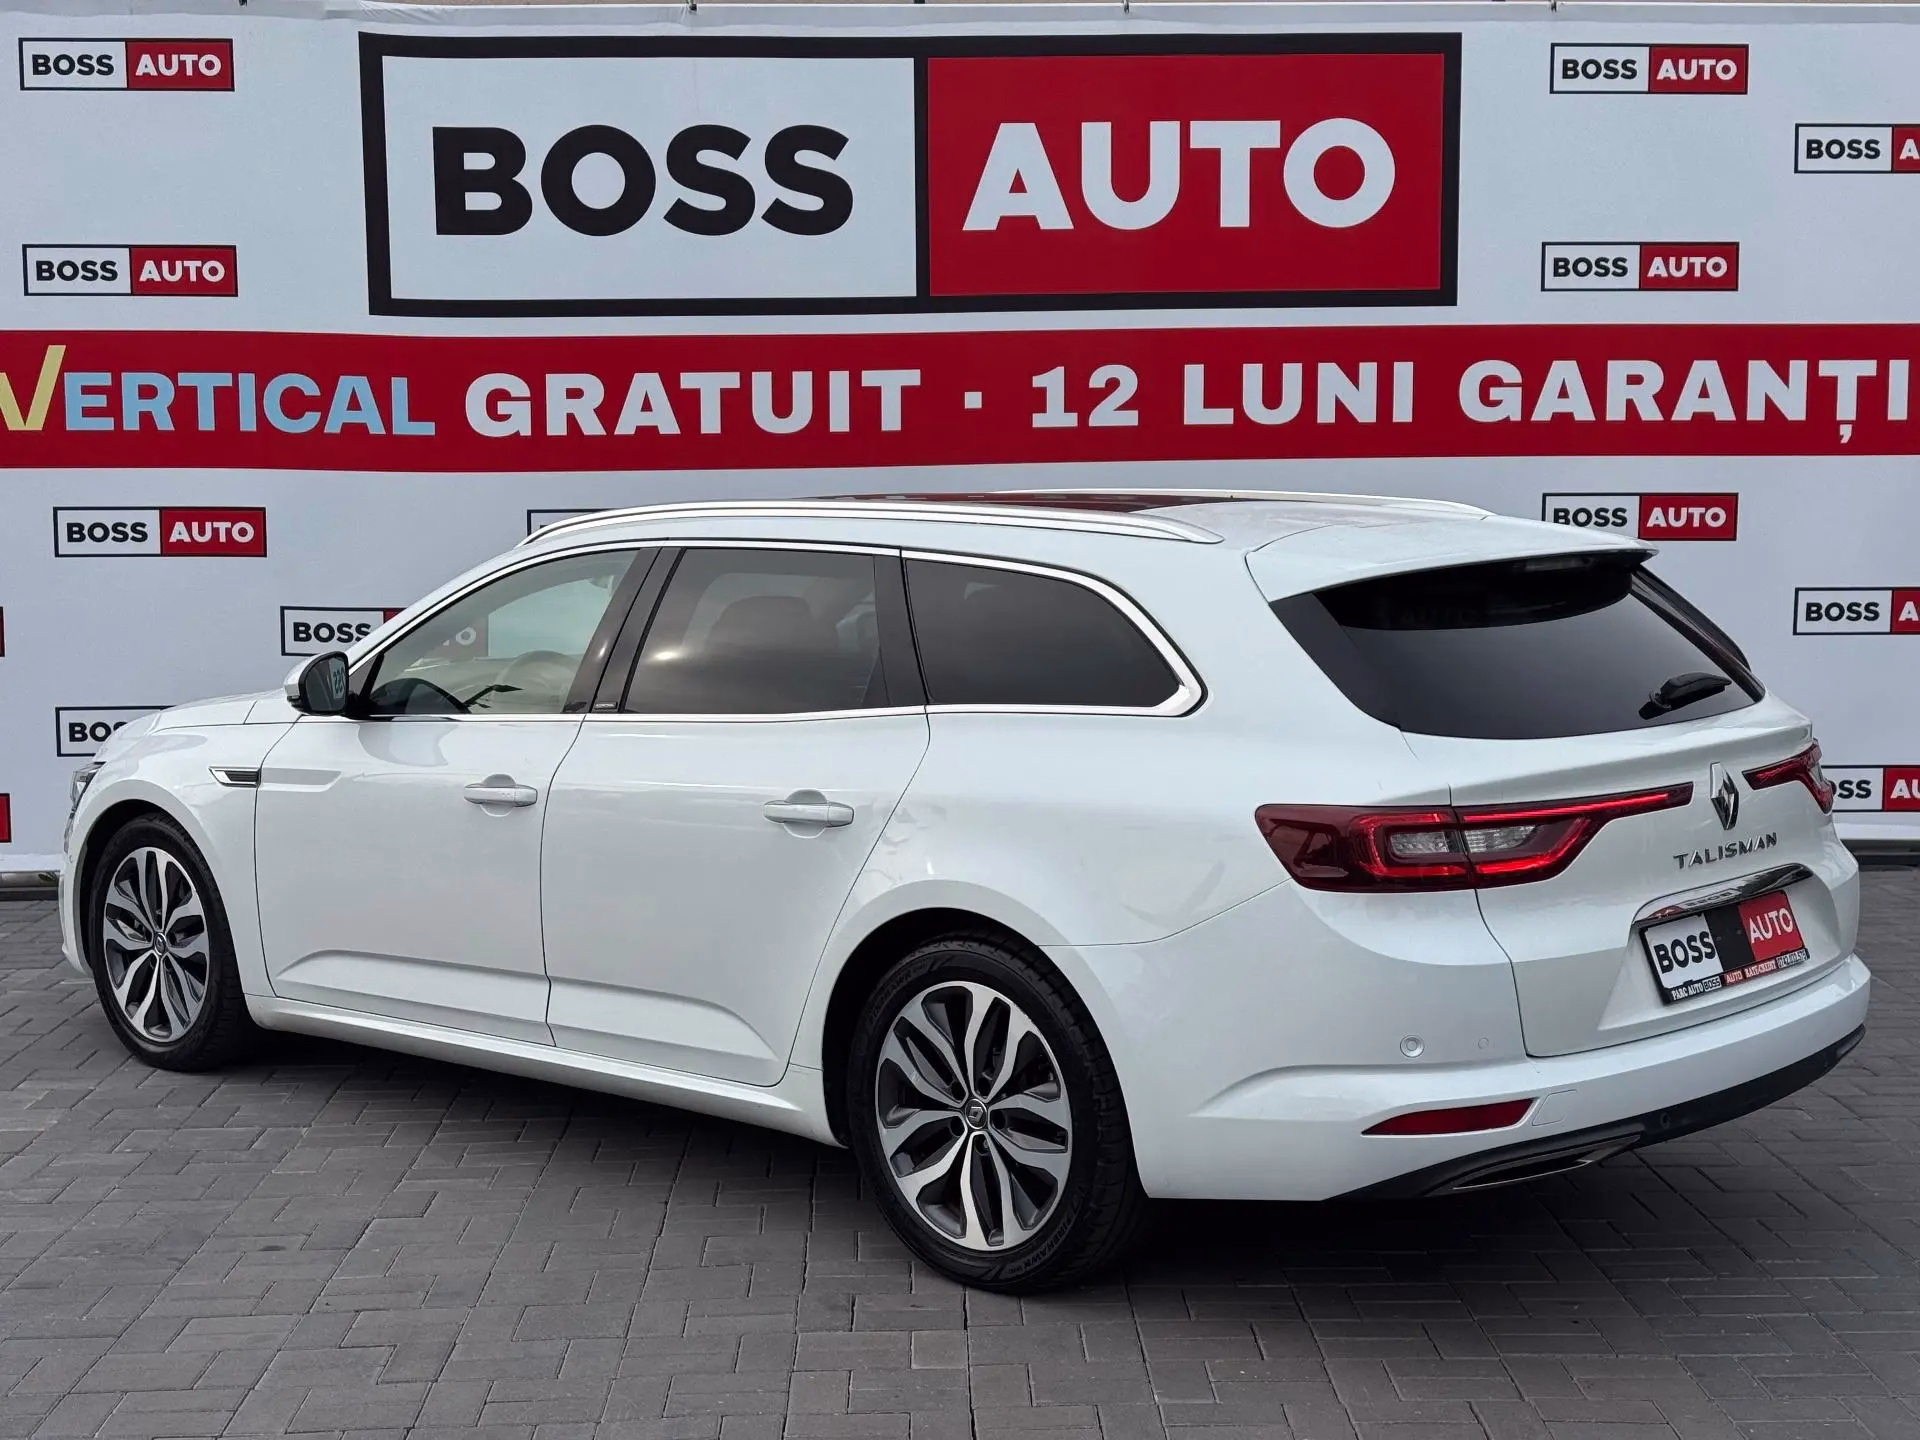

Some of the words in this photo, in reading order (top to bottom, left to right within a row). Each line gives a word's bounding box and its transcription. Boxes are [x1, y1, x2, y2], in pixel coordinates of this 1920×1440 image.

[32, 54, 115, 76] BOSS
[136, 54, 222, 77] AUTO
[1562, 58, 1638, 80] BOSS
[1656, 58, 1738, 80] AUTO
[1806, 139, 1881, 160] BOSS
[433, 124, 854, 237] BOSS
[963, 117, 1396, 231] AUTO
[35, 260, 118, 282] BOSS
[140, 260, 225, 283] AUTO
[1553, 256, 1628, 278] BOSS
[1647, 256, 1729, 278] AUTO
[0, 345, 436, 437] VERTICAL
[465, 369, 922, 438] GRATUIT
[1032, 364, 1139, 428] 12
[1183, 362, 1414, 425] LUNI
[1458, 359, 1910, 444] GARANȚI
[1553, 507, 1628, 527] BOSS
[1646, 506, 1727, 528] AUTO
[66, 521, 148, 543] BOSS
[169, 521, 255, 543] AUTO
[1805, 601, 1880, 622] BOSS
[293, 621, 371, 643] BOSS
[1673, 832, 1777, 869] TALISMAN
[1653, 930, 1717, 974] BOSS
[1749, 907, 1794, 944] AUTO
[1671, 986, 1689, 1001] PARC
[1688, 982, 1704, 996] AUTO
[1704, 977, 1721, 990] BOSS
[1726, 970, 1743, 983] AUTO
